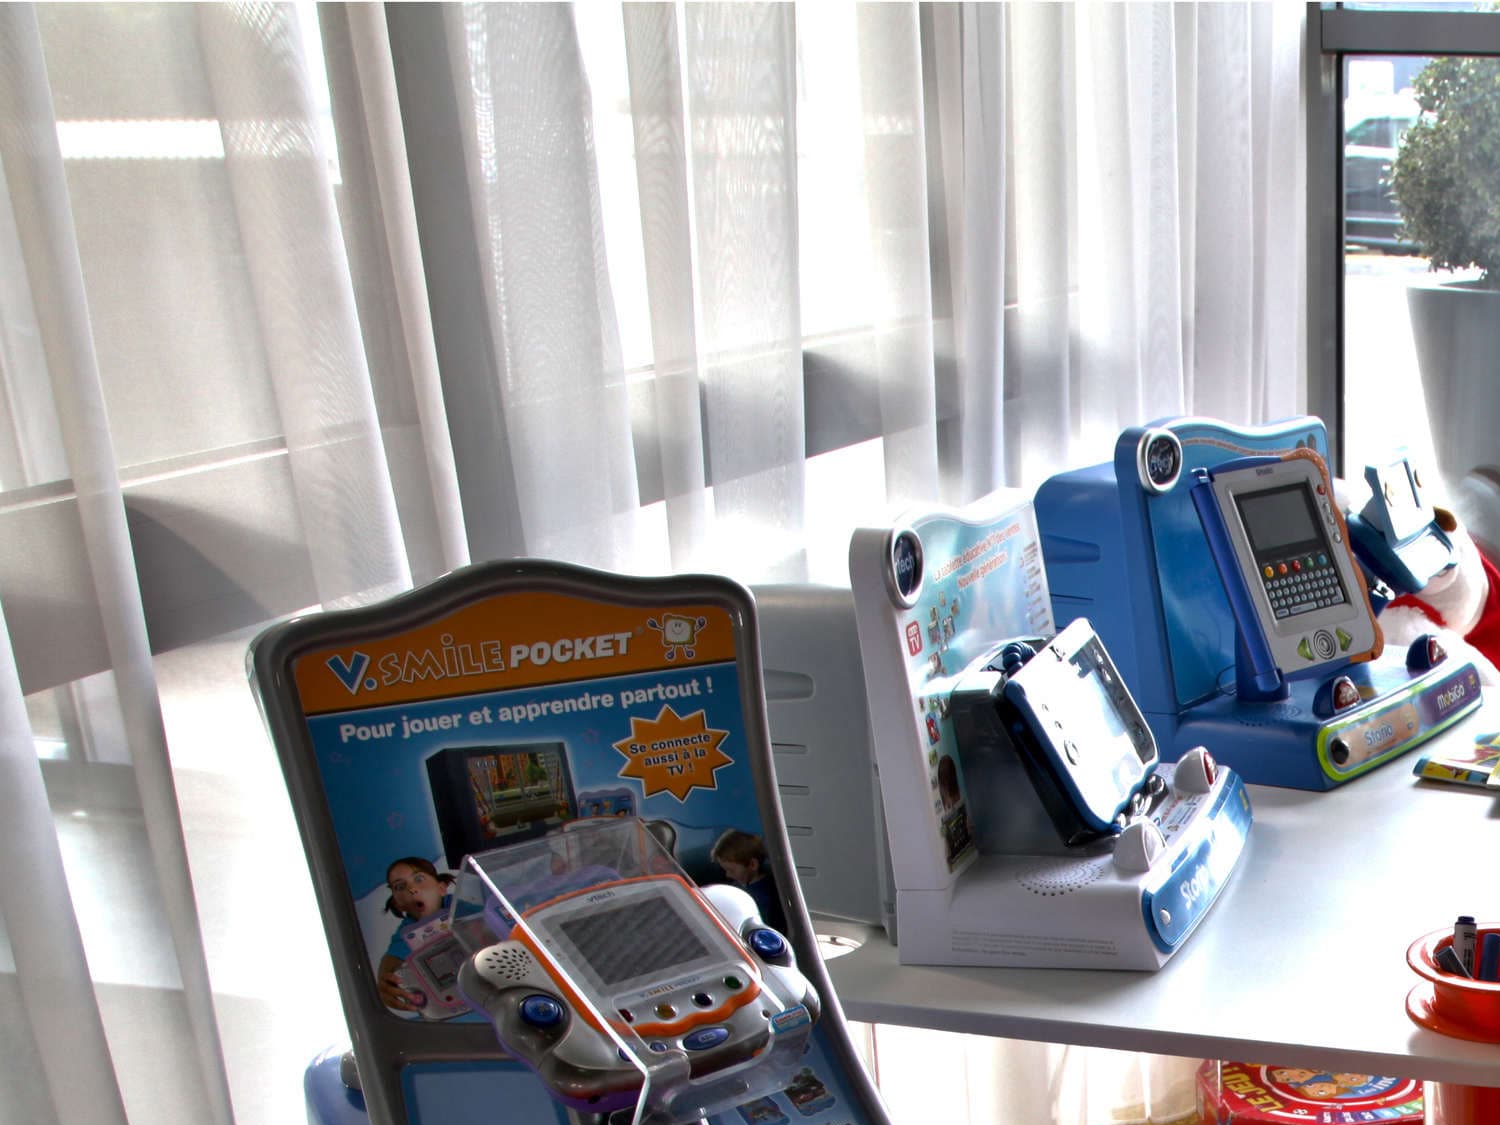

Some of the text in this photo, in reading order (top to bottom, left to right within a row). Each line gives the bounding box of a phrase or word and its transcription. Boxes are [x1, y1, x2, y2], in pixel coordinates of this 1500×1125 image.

[509, 632, 633, 669] POCKET
[339, 675, 714, 744] Pour jouer et apprendre partout !
[629, 734, 711, 755] Se connecte
[644, 748, 707, 767] aussi à la
[667, 764, 685, 777] TV
